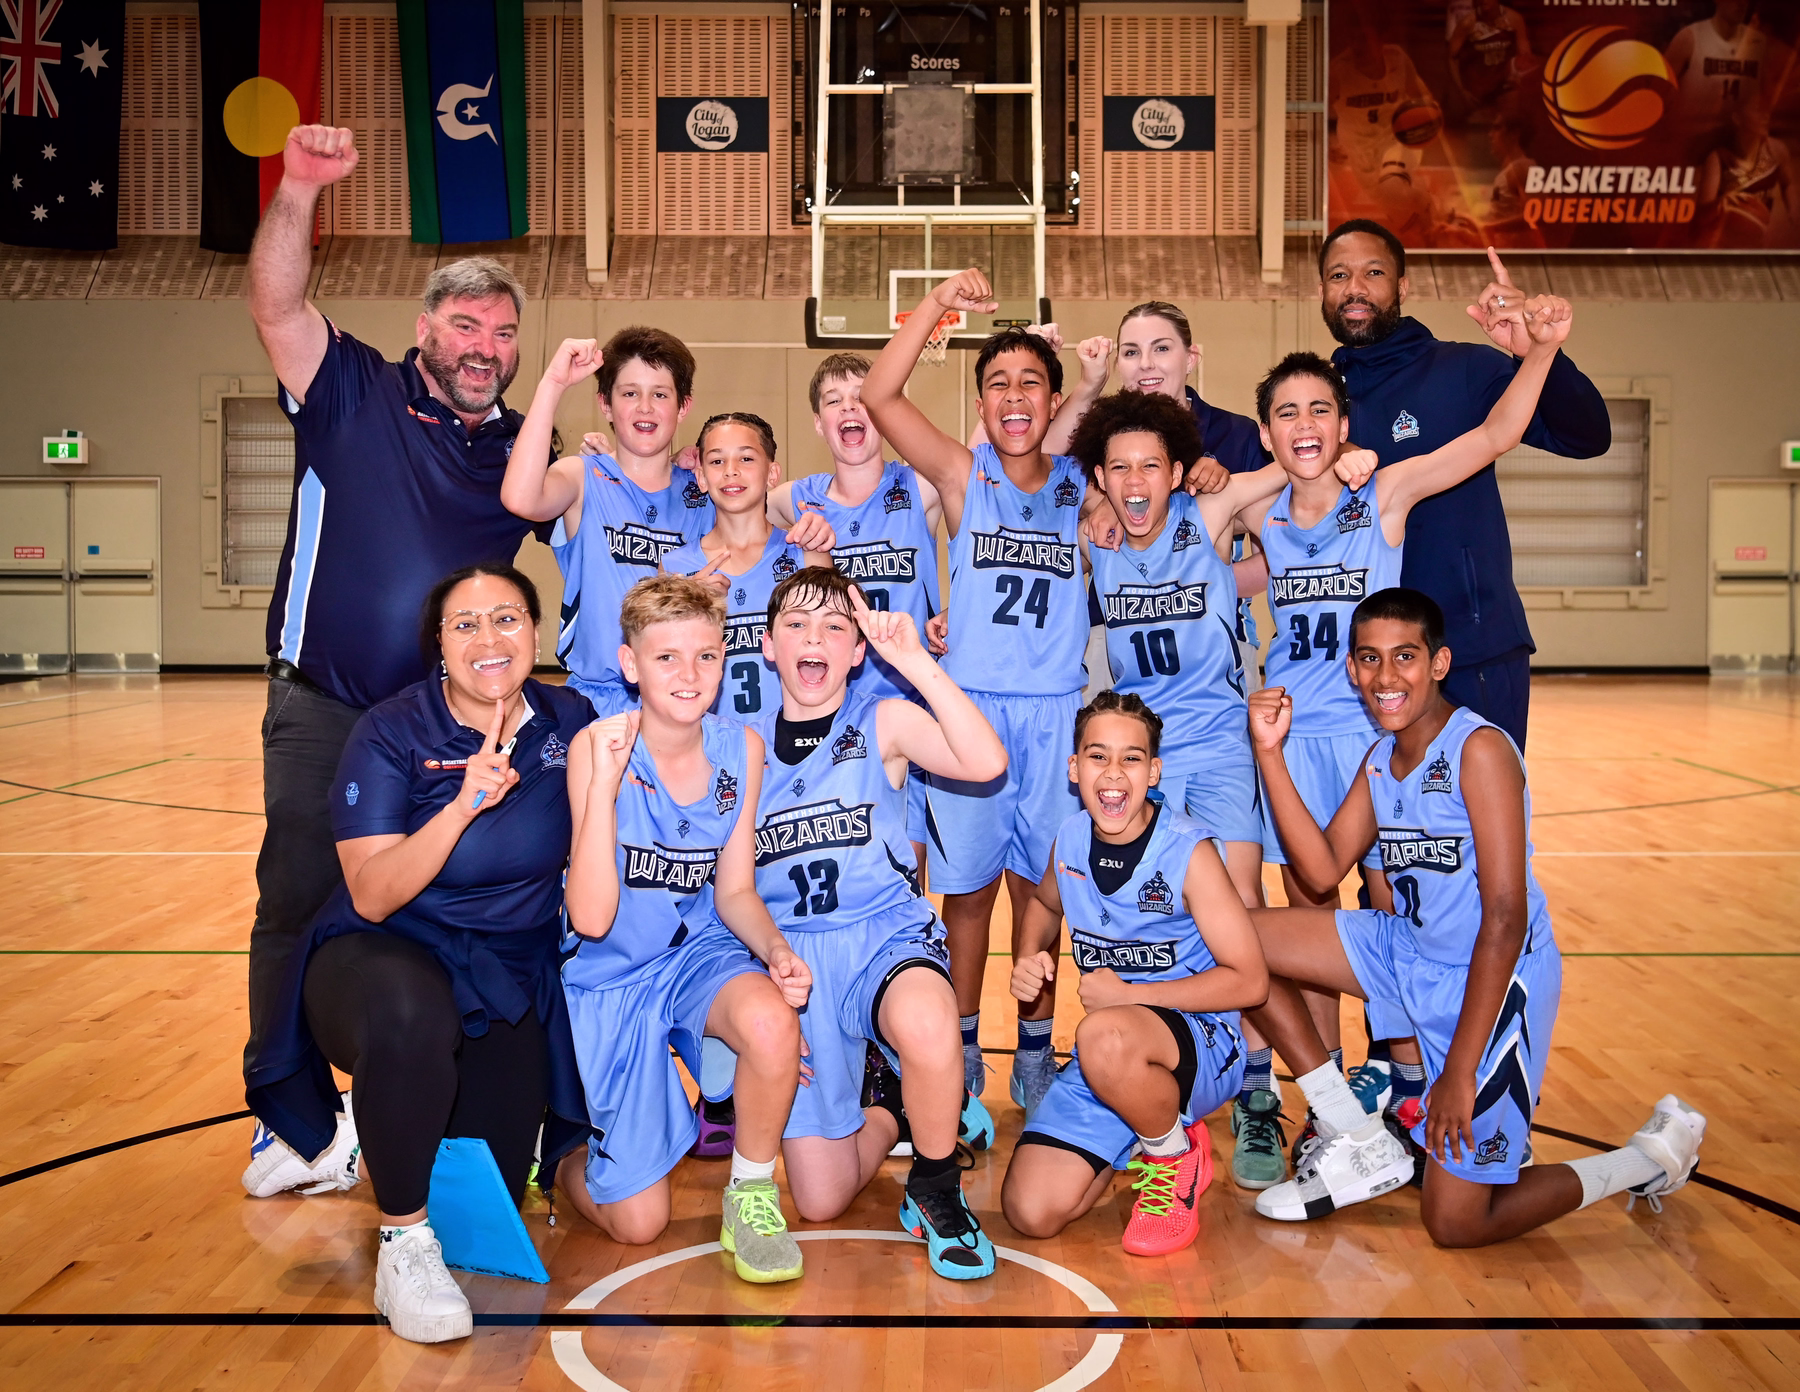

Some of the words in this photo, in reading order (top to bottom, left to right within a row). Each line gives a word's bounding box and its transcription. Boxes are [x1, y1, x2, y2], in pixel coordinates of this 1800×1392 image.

[911, 53, 960, 70] Scores
[694, 108, 718, 125] City
[1138, 121, 1177, 139] Logan
[1141, 107, 1164, 124] City
[692, 122, 730, 140] Logan
[1525, 165, 1697, 194] BASKETBALL
[1523, 197, 1697, 230] QUEENSLAND
[606, 529, 681, 564] WIZAR
[1005, 531, 1053, 542] NORTHSIDE
[976, 535, 1072, 573] WIZARDS
[1273, 571, 1364, 602] WIZARDS
[992, 574, 1051, 629] 24
[1104, 585, 1203, 622] WIZARDS
[1288, 611, 1340, 662] 34
[1129, 627, 1181, 678] 10
[730, 661, 762, 715] 3
[794, 736, 824, 748] 2XU
[1422, 780, 1452, 793] WIZARDS
[773, 803, 834, 825] NORTHSIDE
[755, 807, 869, 861] WIZARDS
[1099, 857, 1124, 870] 2XU
[787, 857, 840, 917] 13
[1139, 901, 1173, 916] WIZARDS
